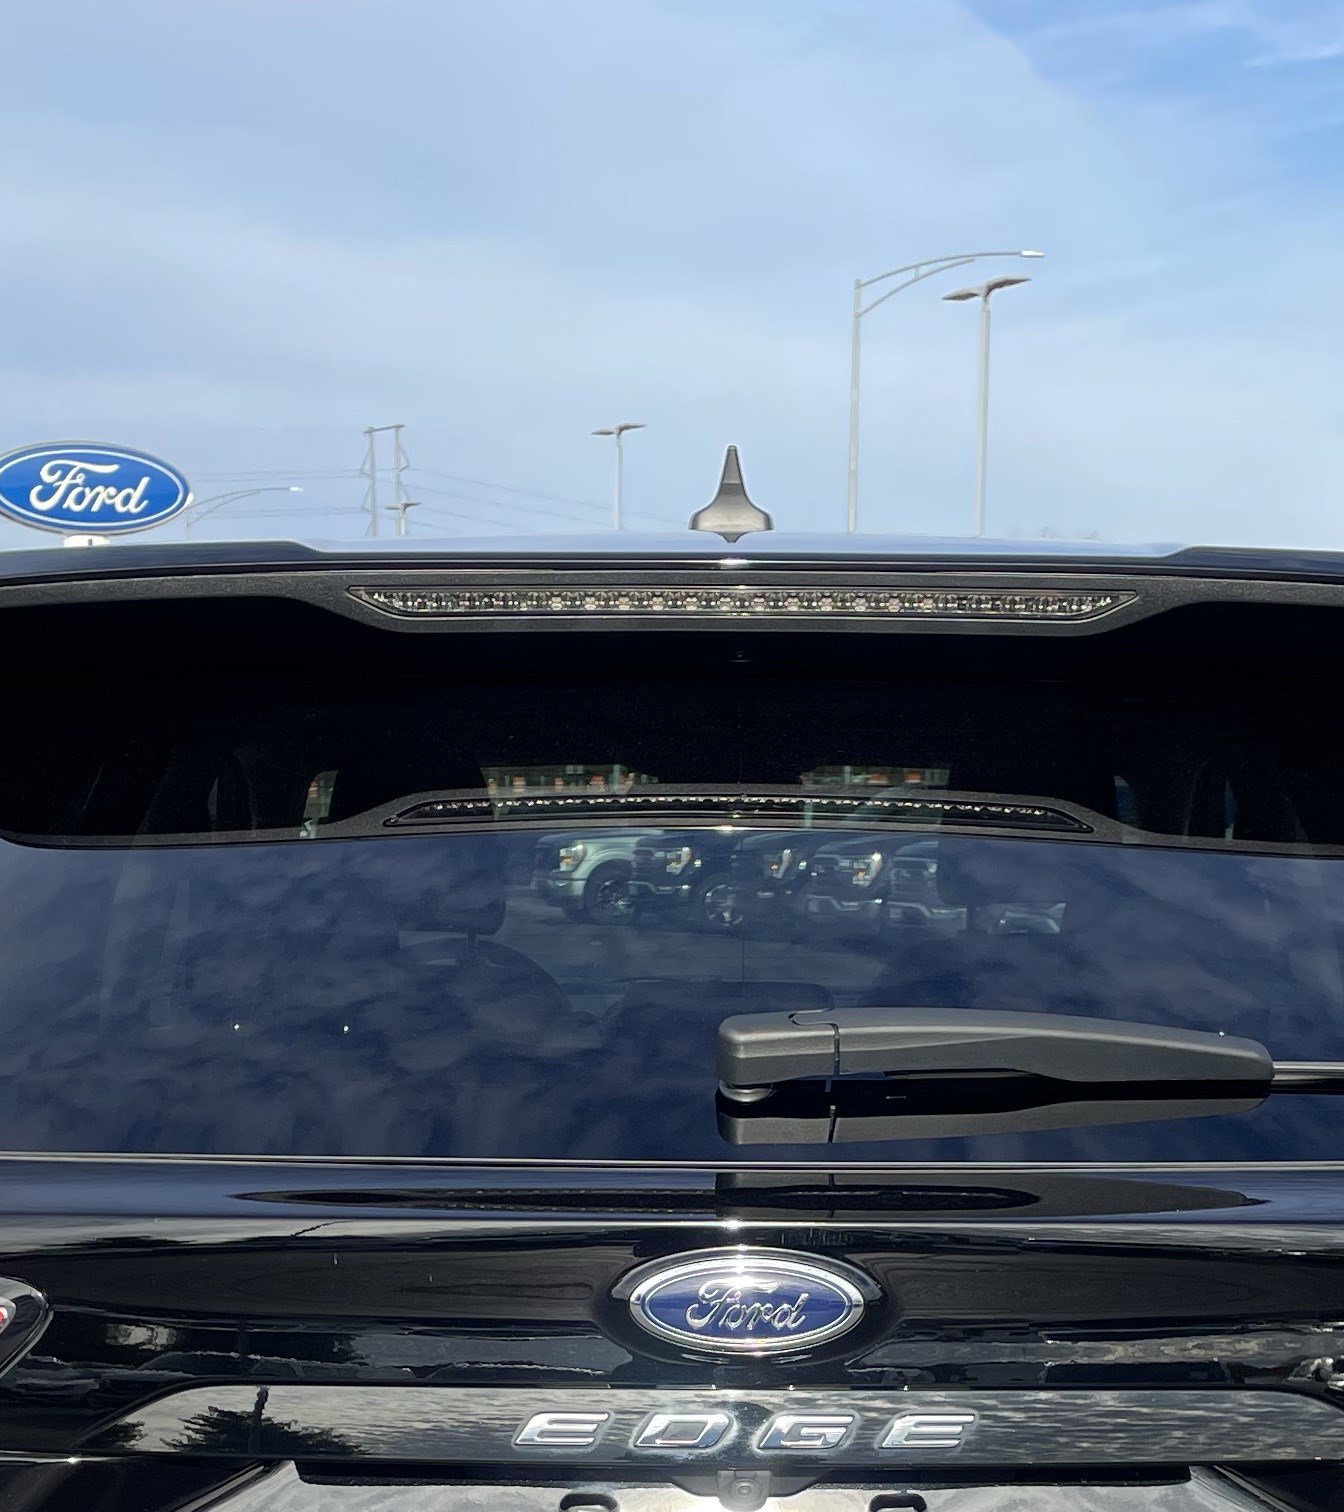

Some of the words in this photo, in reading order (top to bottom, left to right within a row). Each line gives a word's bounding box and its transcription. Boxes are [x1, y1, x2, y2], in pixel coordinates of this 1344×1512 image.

[29, 459, 151, 513] Ford
[686, 1276, 809, 1330] Ford
[513, 1411, 976, 1448] EDGE
